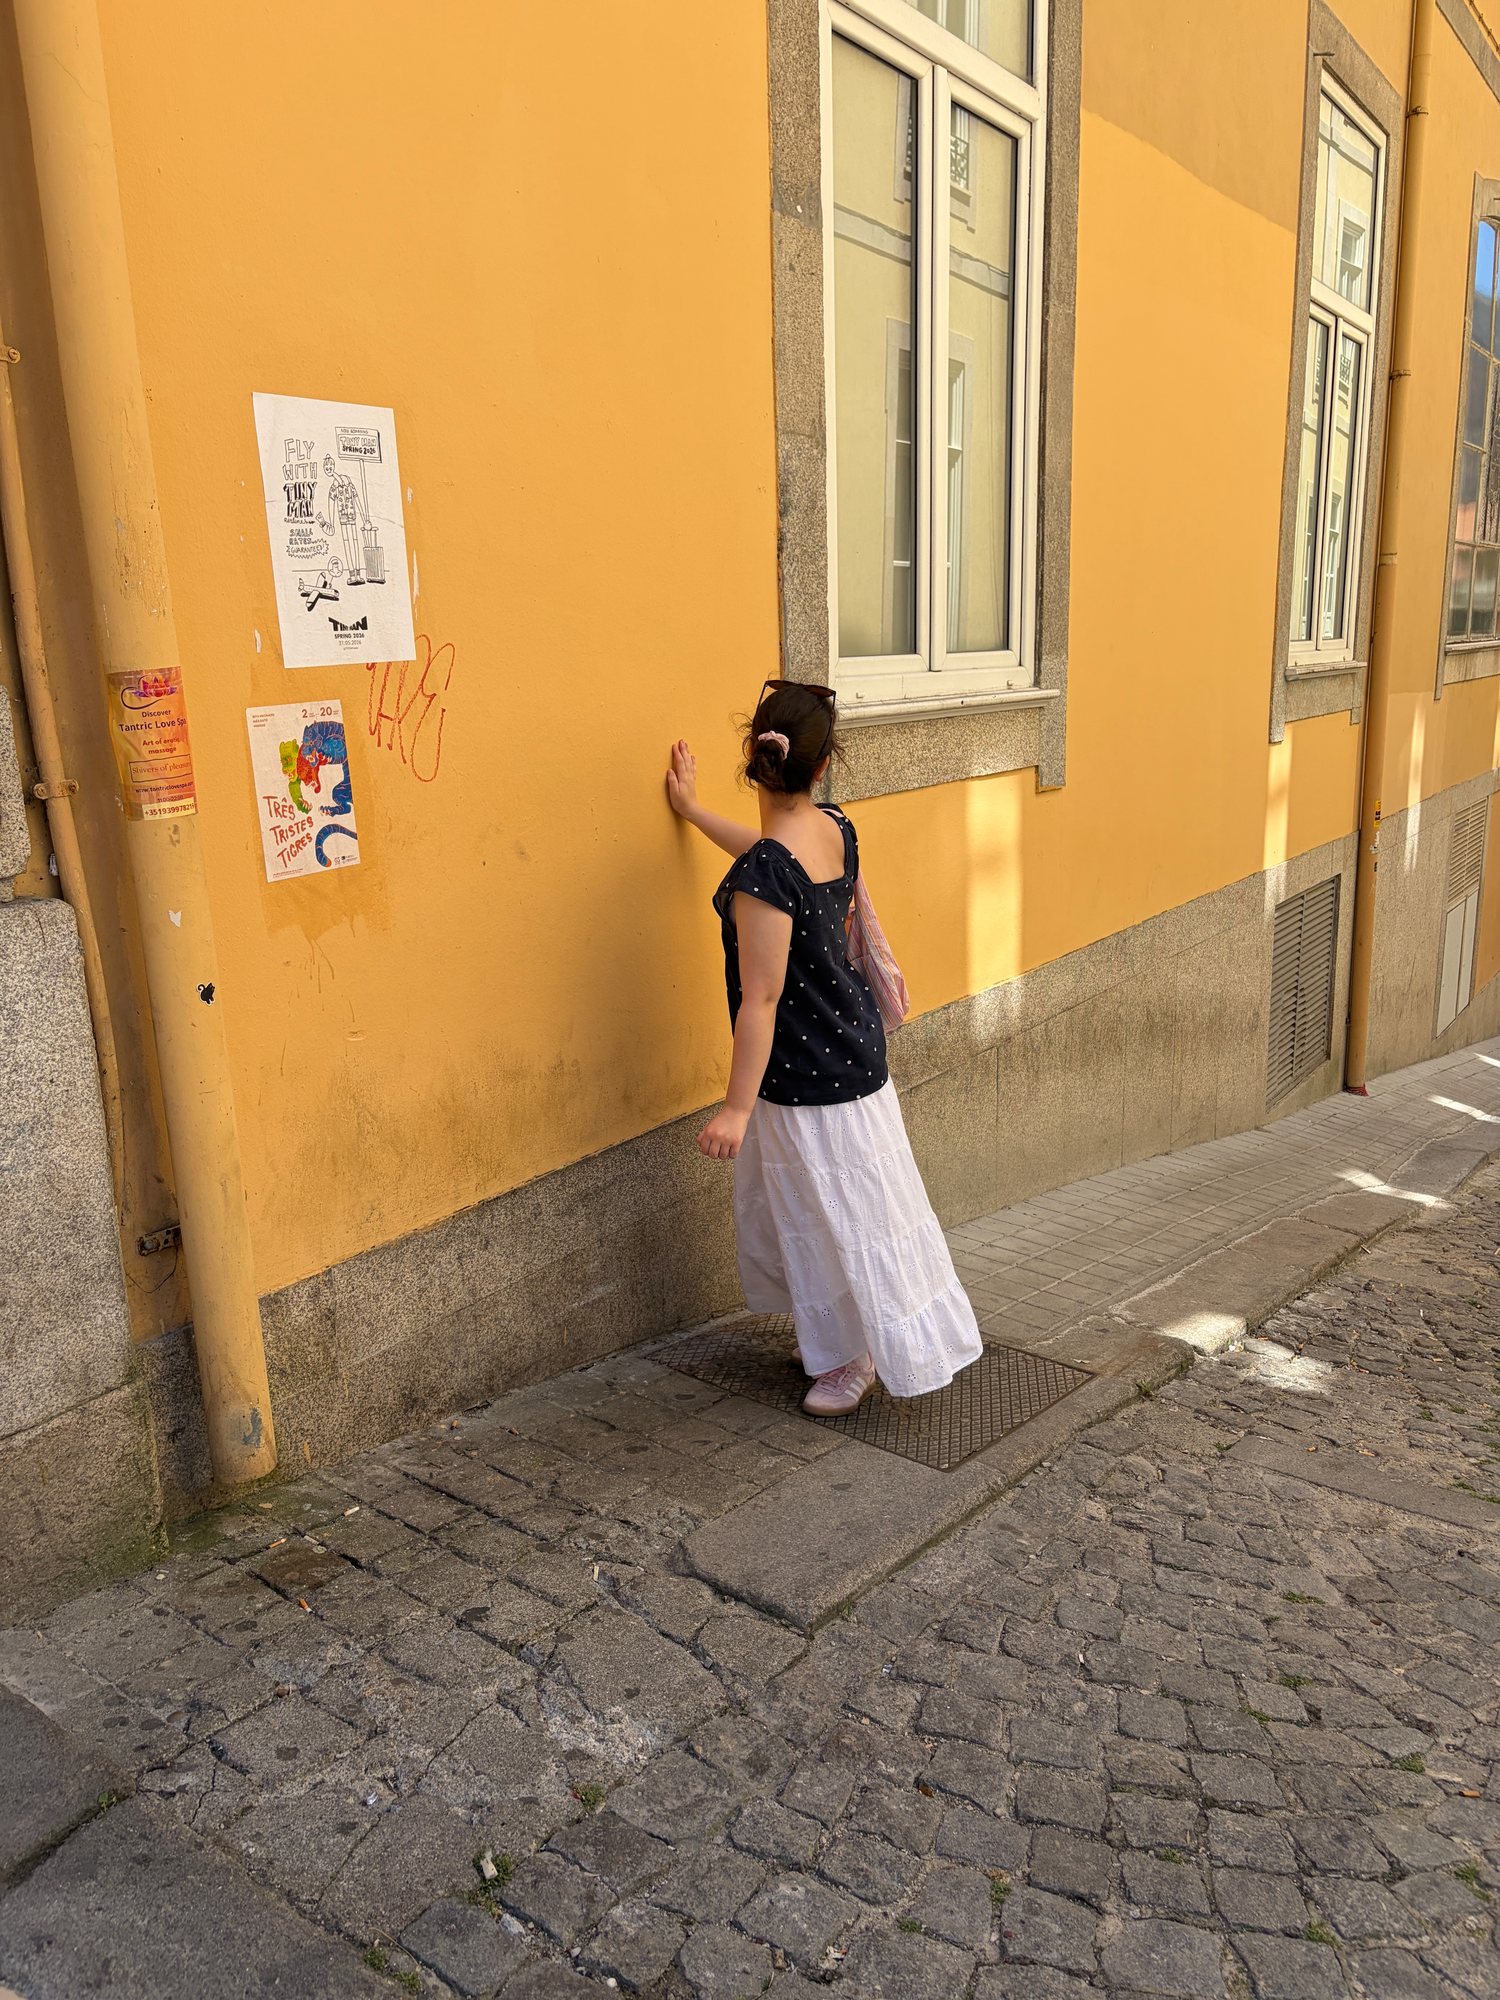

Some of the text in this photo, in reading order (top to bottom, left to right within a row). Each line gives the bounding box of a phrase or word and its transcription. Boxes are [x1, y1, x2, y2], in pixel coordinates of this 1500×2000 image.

[284, 438, 315, 463] FLY
[342, 445, 362, 454] SPRING
[282, 462, 317, 480] WITH
[283, 481, 318, 502] TINY
[286, 500, 314, 518] MAN
[141, 709, 172, 718] Discover
[301, 708, 308, 719] 2
[320, 706, 333, 717] 20
[118, 721, 153, 732] Tantric
[155, 719, 176, 729] Love
[155, 737, 162, 745] of
[262, 795, 296, 821] TRÊS
[269, 816, 314, 846] TRISTES
[276, 832, 313, 868] TIGRES
